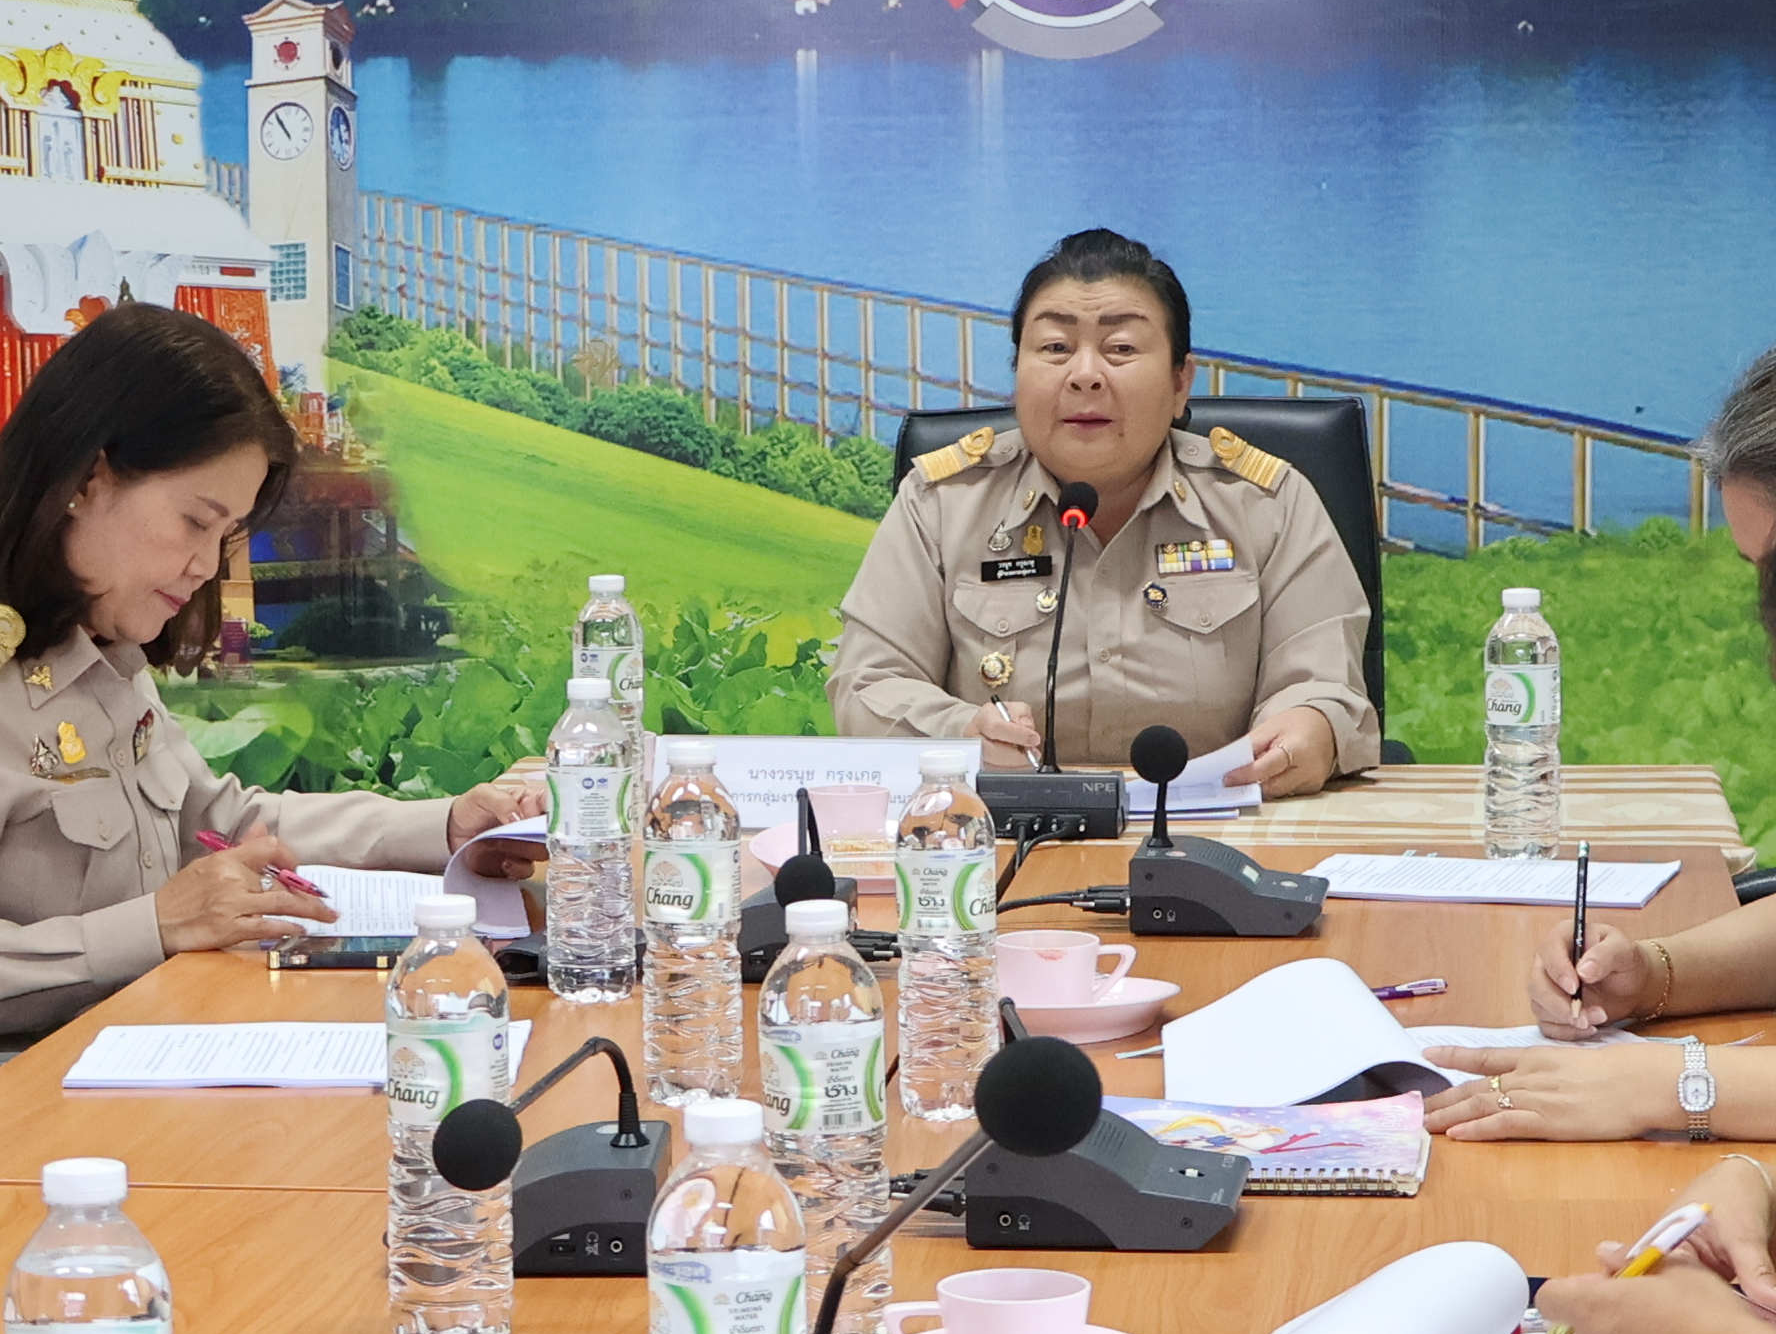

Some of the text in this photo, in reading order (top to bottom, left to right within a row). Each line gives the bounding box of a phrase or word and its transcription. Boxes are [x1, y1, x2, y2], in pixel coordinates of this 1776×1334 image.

[1486, 697, 1522, 717] Chang
[748, 767, 815, 786] นางวรนุช
[1082, 781, 1116, 793] NPE
[730, 788, 800, 807] การกลุ่มงา
[646, 886, 694, 911] Chang
[969, 897, 997, 917] Cha
[830, 1047, 861, 1060] Chang
[387, 1077, 440, 1110] Chang
[765, 1093, 792, 1117] ang
[735, 1289, 773, 1305] Chang
